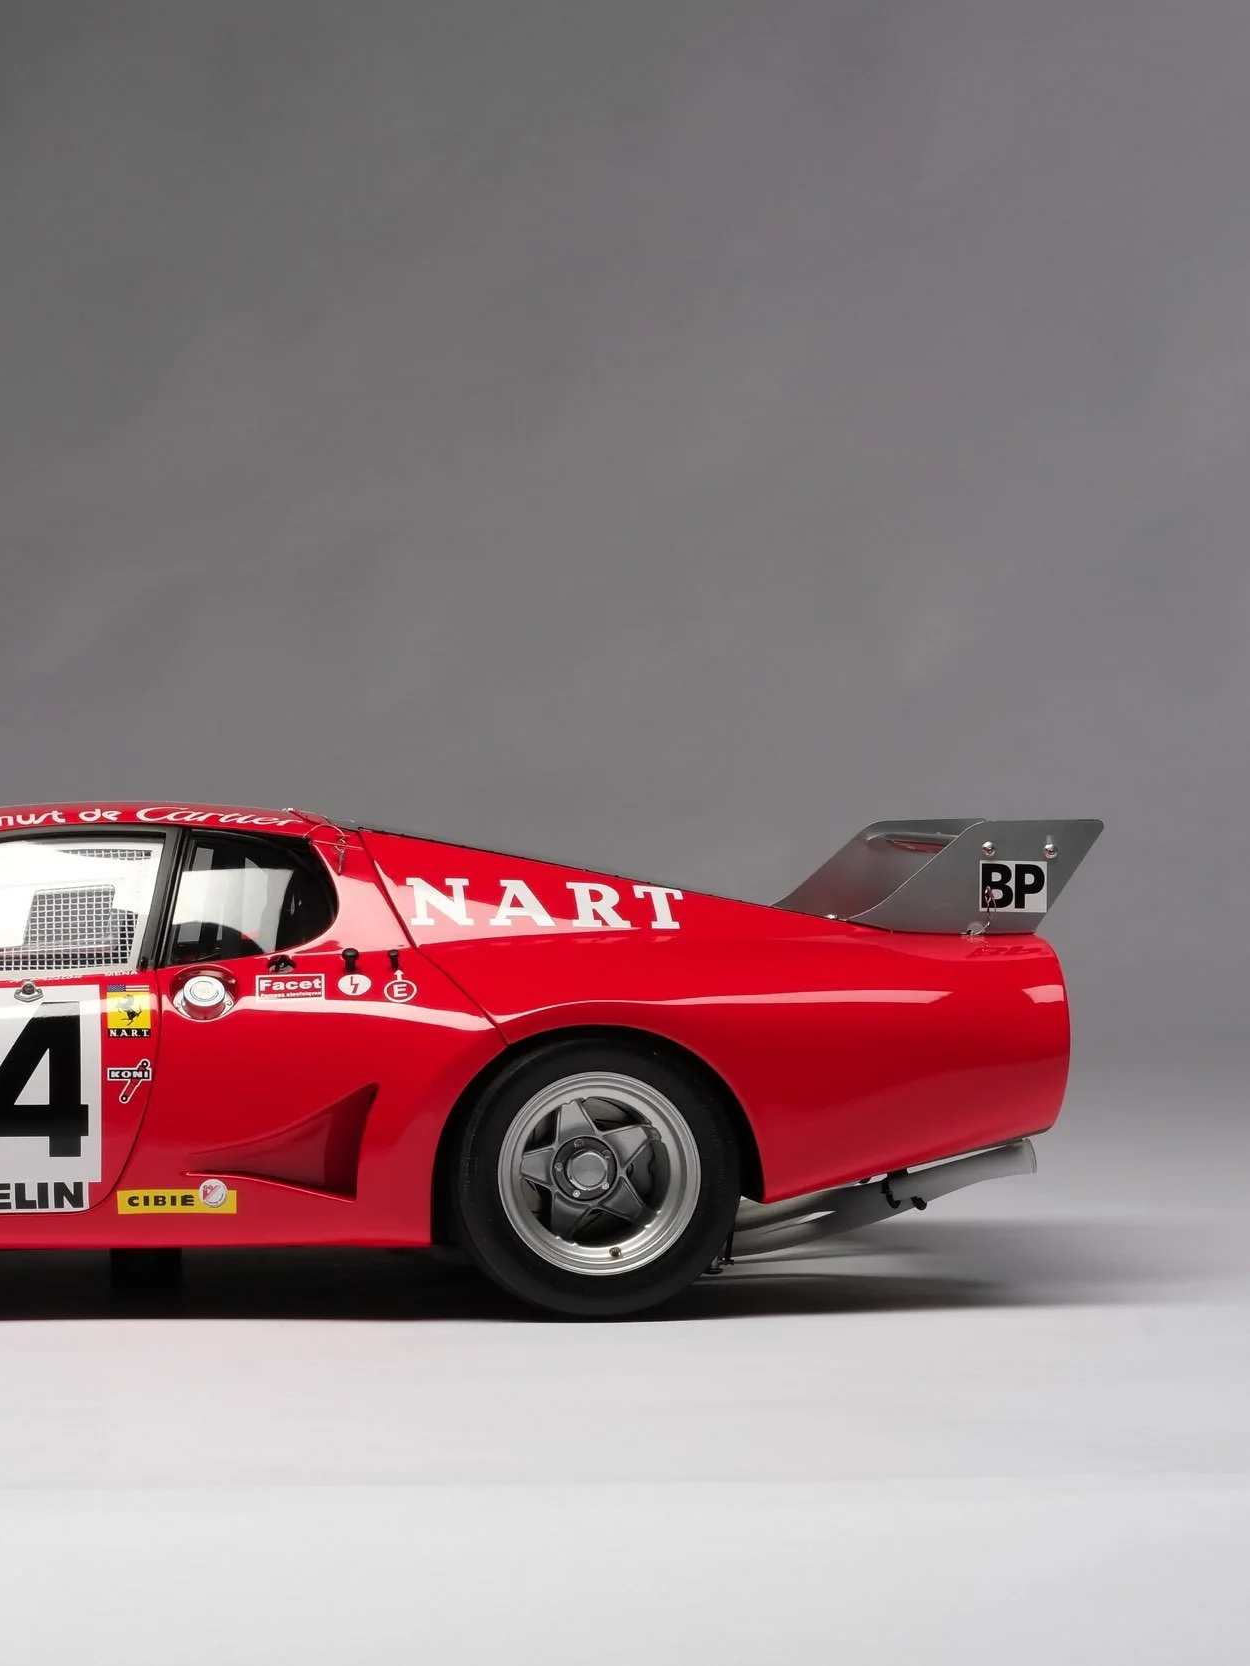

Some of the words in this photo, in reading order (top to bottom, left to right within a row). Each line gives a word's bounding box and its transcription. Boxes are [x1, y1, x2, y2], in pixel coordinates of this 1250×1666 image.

[78, 808, 122, 821] de
[135, 806, 303, 826] Cartier
[981, 863, 1045, 910] BP
[405, 877, 684, 930] NART
[259, 977, 322, 992] Facet
[393, 984, 408, 998] E
[109, 1029, 150, 1037] N.A.R.T.
[110, 1070, 149, 1078] KONI
